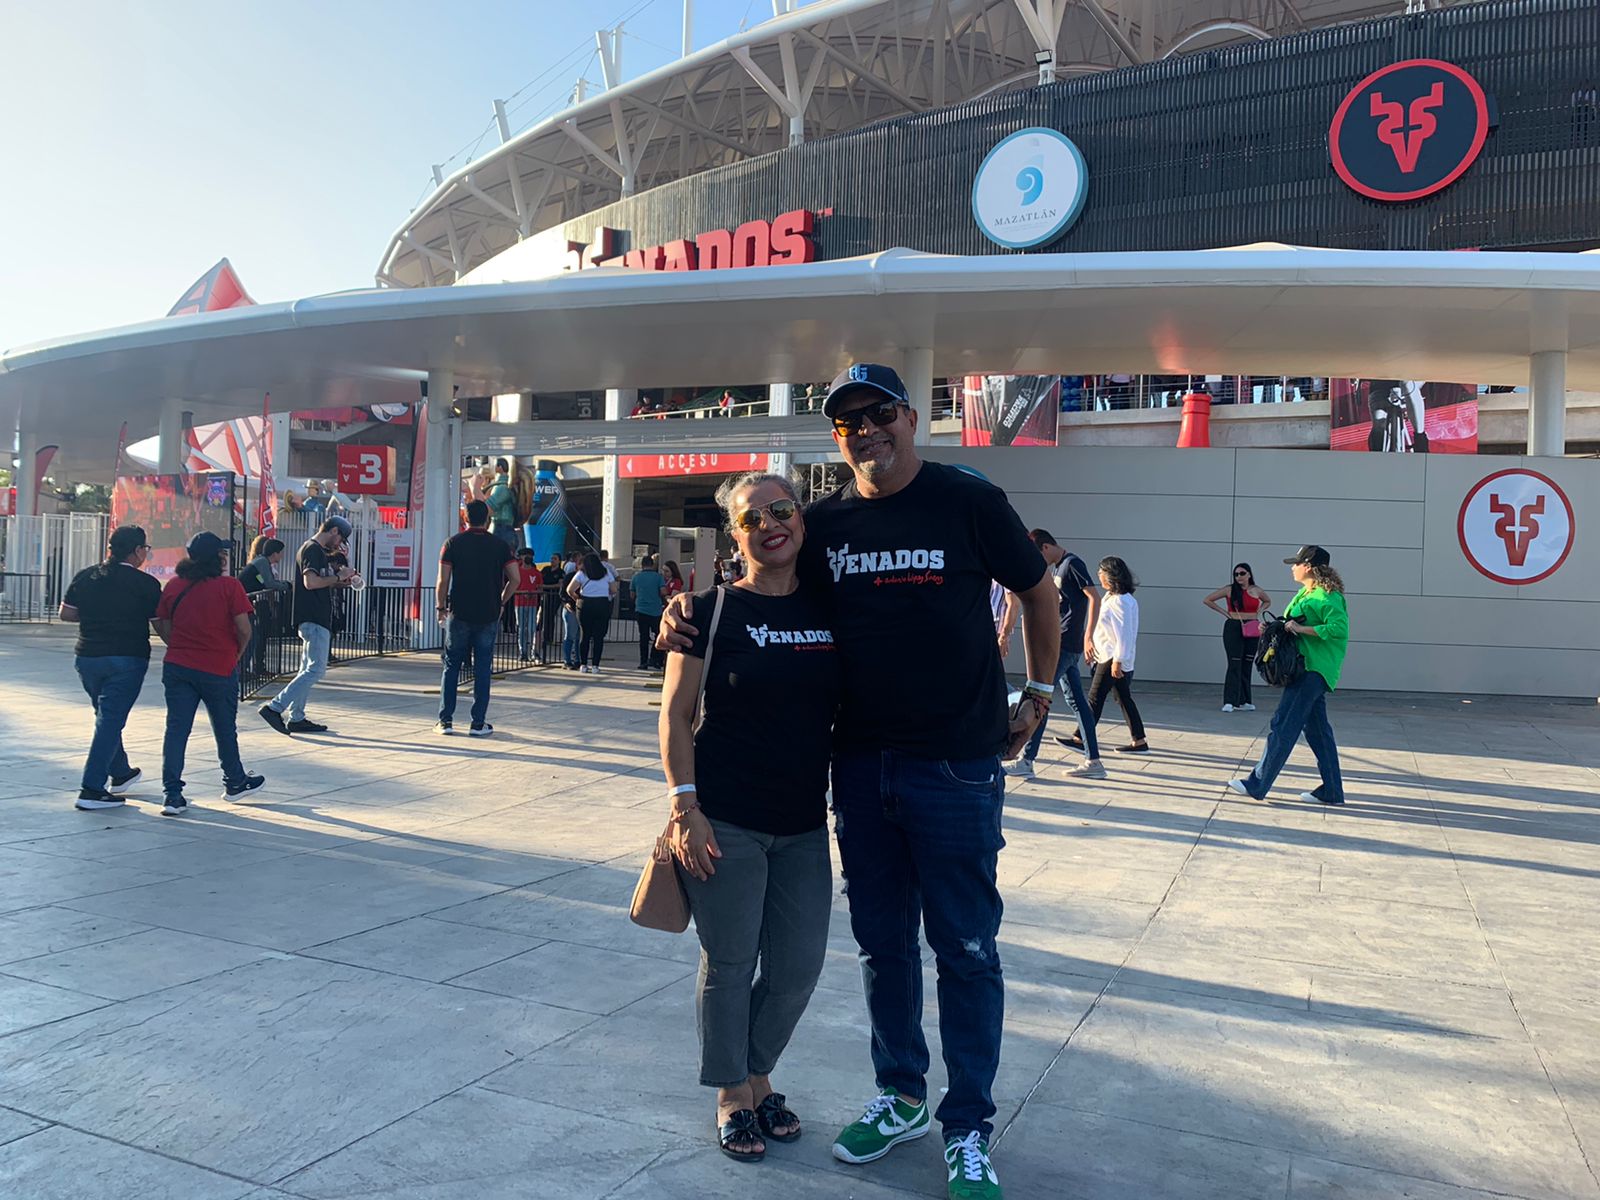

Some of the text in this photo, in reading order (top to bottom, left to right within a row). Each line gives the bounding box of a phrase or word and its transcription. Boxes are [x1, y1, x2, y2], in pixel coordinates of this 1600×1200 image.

[360, 453, 382, 485] 3
[658, 454, 718, 469] ACCESO
[826, 543, 945, 582] VENADOS
[745, 623, 834, 647] VENADOS
